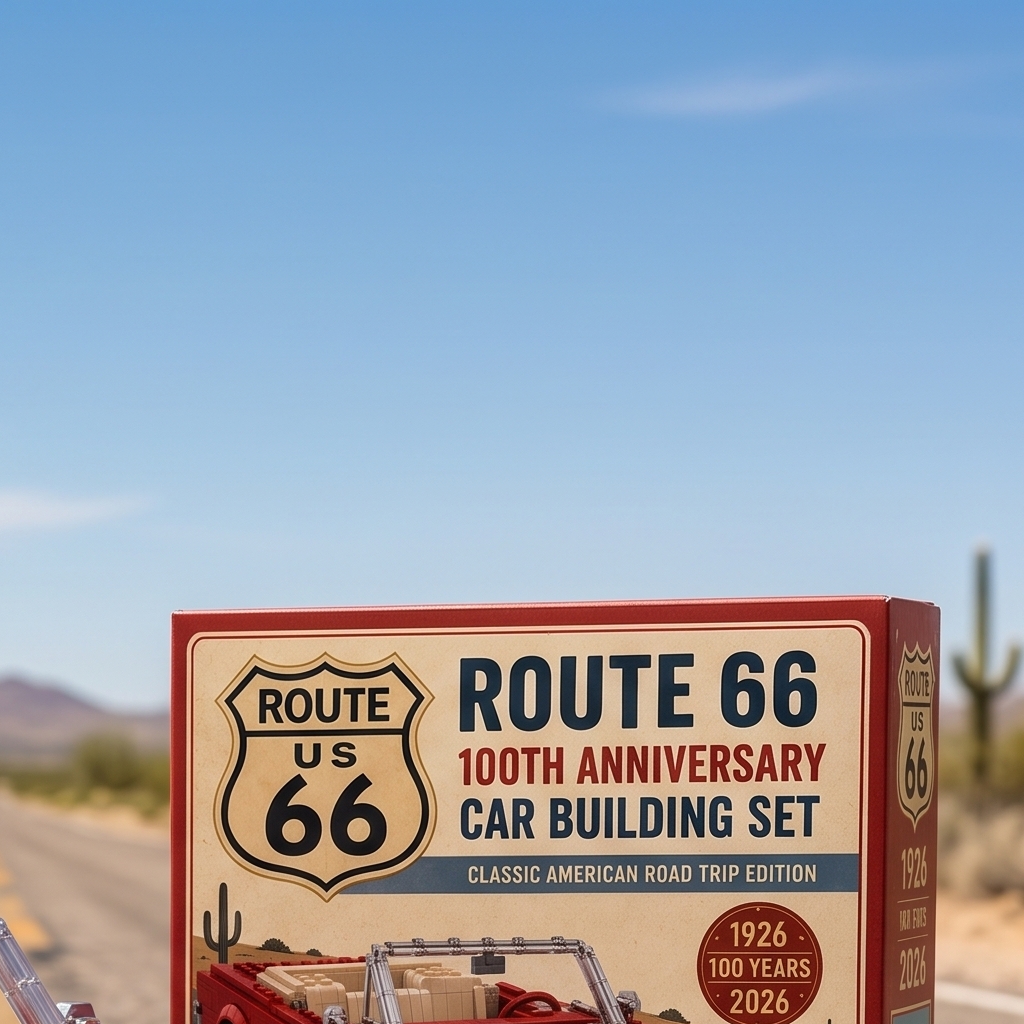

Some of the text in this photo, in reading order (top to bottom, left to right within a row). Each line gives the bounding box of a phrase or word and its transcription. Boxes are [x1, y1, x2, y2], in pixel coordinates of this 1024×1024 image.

[458, 650, 818, 733] ROUTE 66
[904, 669, 930, 697] ROUTE
[257, 686, 390, 724] ROUTE
[911, 711, 924, 732] US
[293, 741, 357, 769] US
[458, 743, 827, 786] 100TH ANNIVERSARY
[905, 737, 927, 800] 66
[264, 773, 388, 857] 66
[459, 794, 821, 841] CAR BUILDING SET
[467, 863, 817, 884] CLASSIC AMERICAN ROAD TRIP EDITION
[900, 845, 928, 890] 1926
[730, 921, 787, 948] 1926
[708, 957, 811, 978] 100 YEARS
[899, 945, 927, 991] 2026
[729, 988, 790, 1014] 2026
